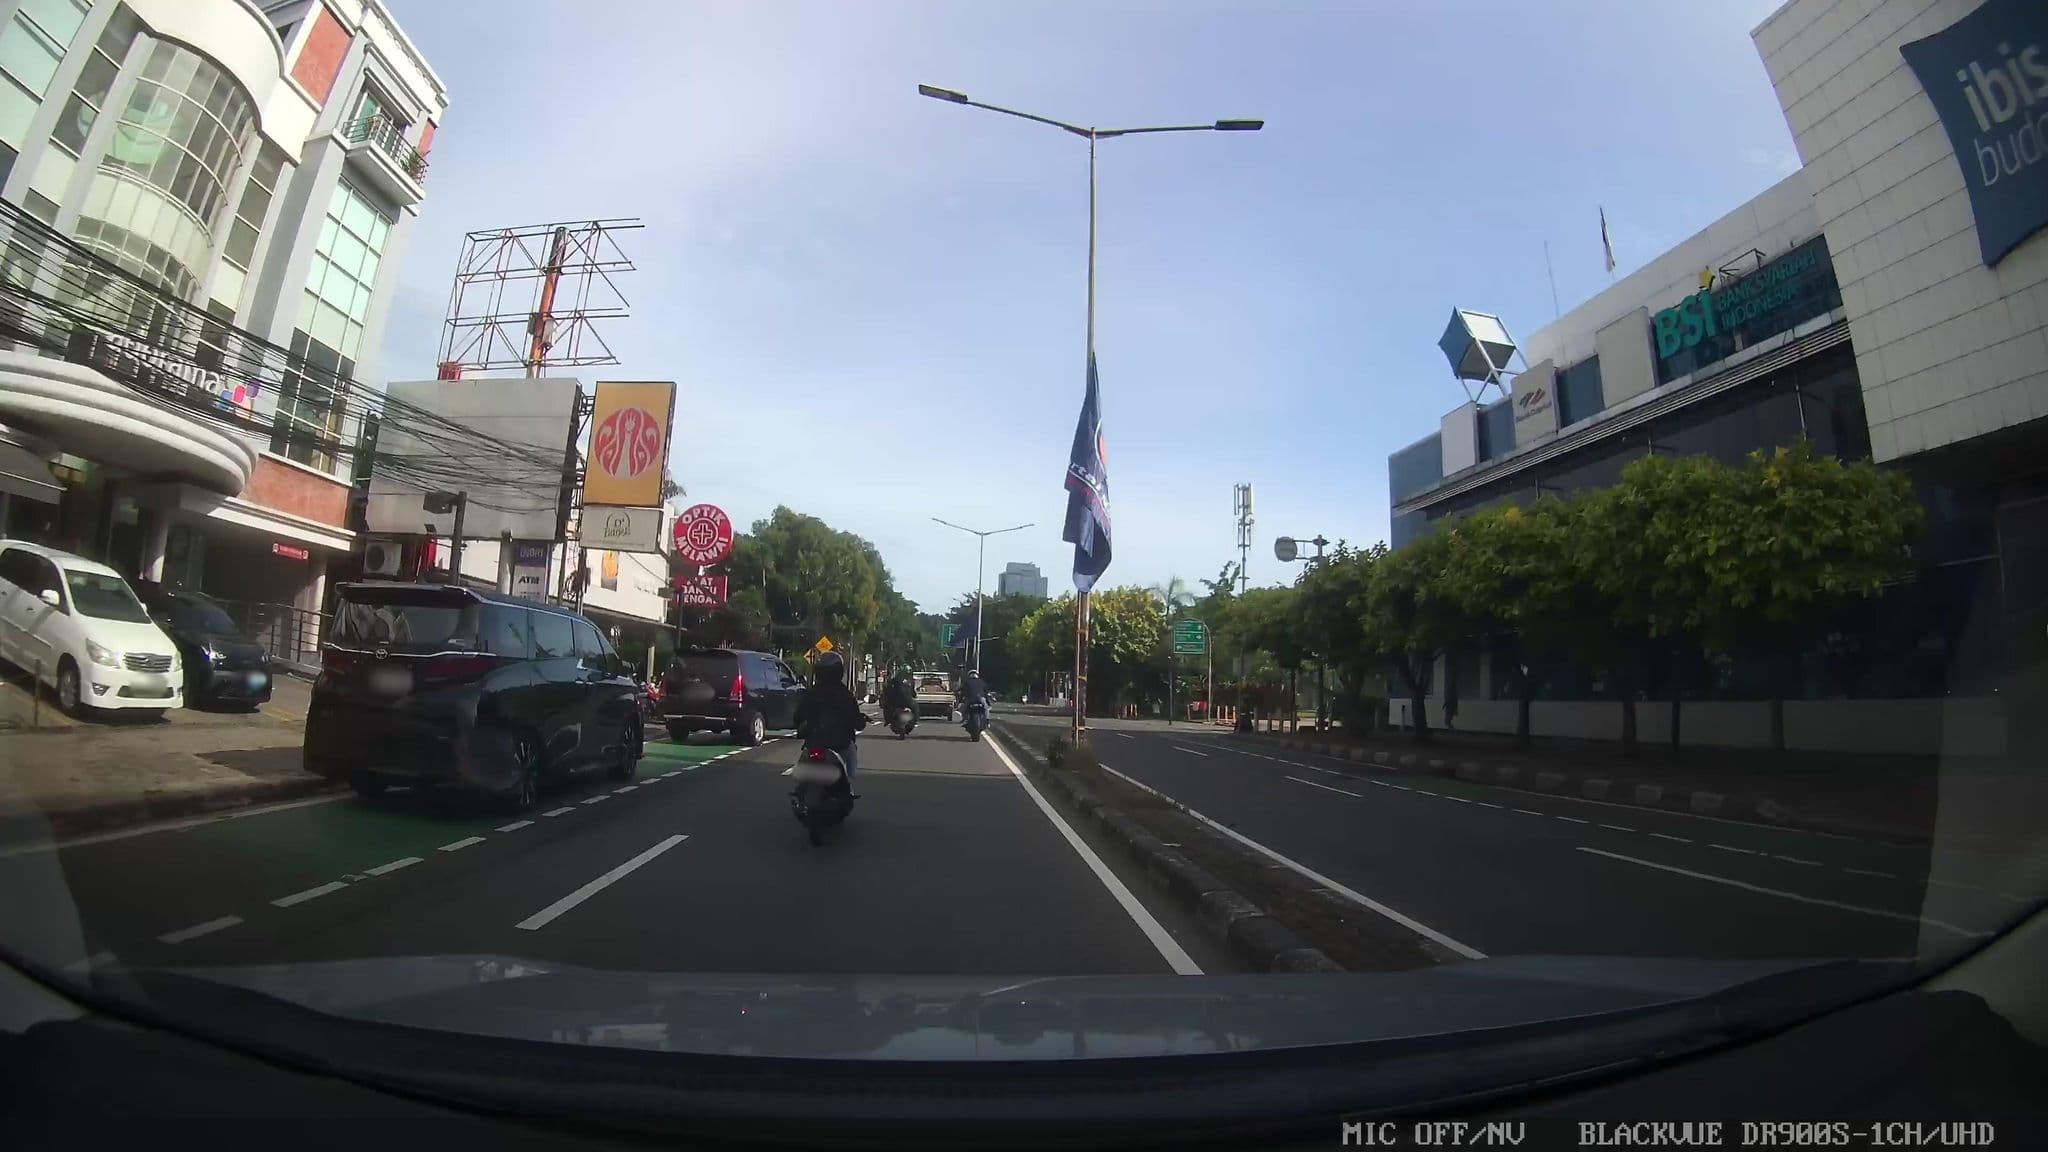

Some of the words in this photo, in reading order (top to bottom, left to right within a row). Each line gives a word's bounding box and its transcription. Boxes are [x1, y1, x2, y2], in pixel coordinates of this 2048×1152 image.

[1956, 41, 2048, 132] ibis
[1719, 283, 1754, 311] BANK
[1721, 286, 1800, 331] INDONESIA
[1655, 290, 1717, 360] BSI
[682, 506, 726, 527] OPTIK
[676, 536, 729, 561] MELAWAI
[518, 576, 540, 585] ATM
